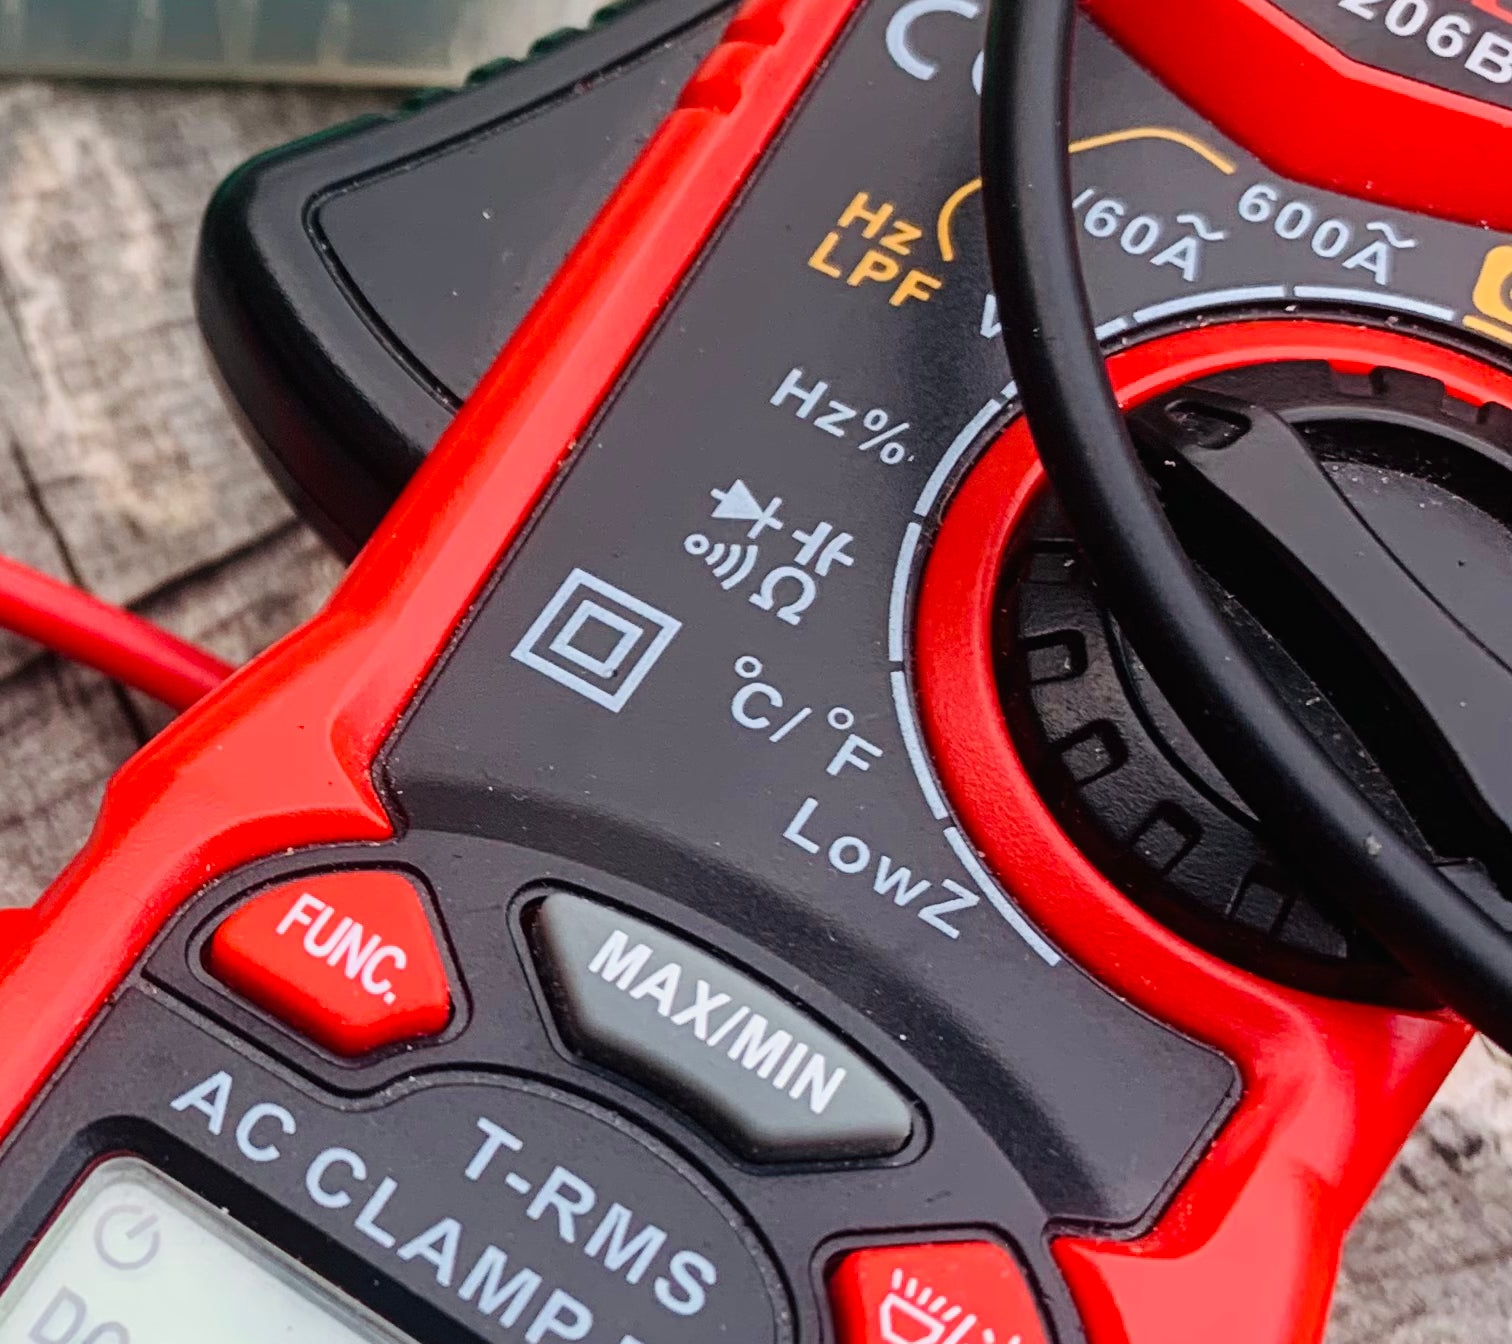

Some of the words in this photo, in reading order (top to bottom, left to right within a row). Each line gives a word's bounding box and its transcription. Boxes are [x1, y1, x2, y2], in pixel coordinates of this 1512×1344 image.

[807, 231, 943, 307] LPF
[837, 191, 923, 257] Hz
[768, 367, 908, 465] Hz%
[274, 894, 408, 1005] FUNC.
[587, 928, 848, 1115] MAX/MIN
[170, 1069, 298, 1163] AC
[462, 1117, 718, 1316] T-RMS
